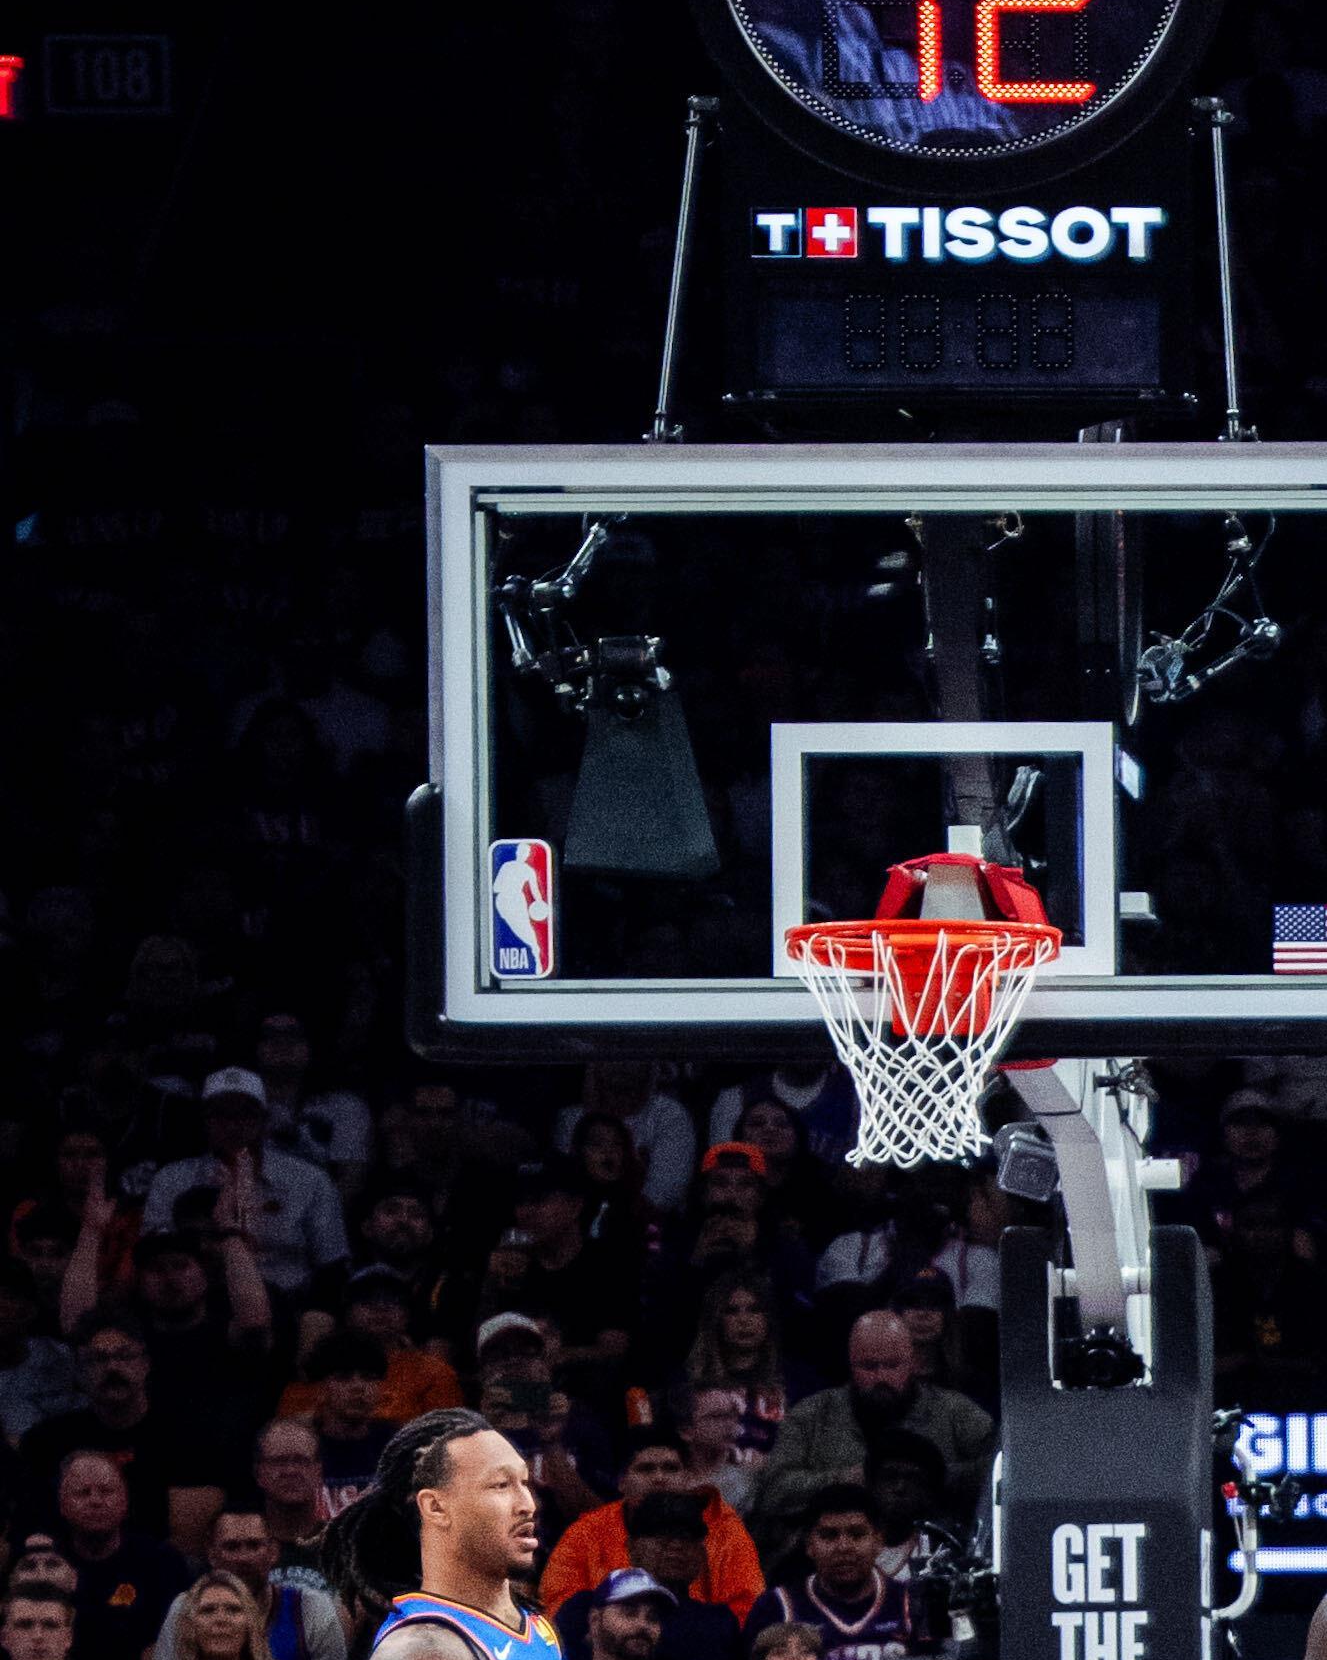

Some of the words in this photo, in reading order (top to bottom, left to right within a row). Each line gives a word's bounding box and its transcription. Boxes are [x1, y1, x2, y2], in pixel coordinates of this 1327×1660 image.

[866, 206, 1163, 259] TISSOT
[500, 947, 529, 970] NBA
[1051, 1523, 1146, 1604] GET
